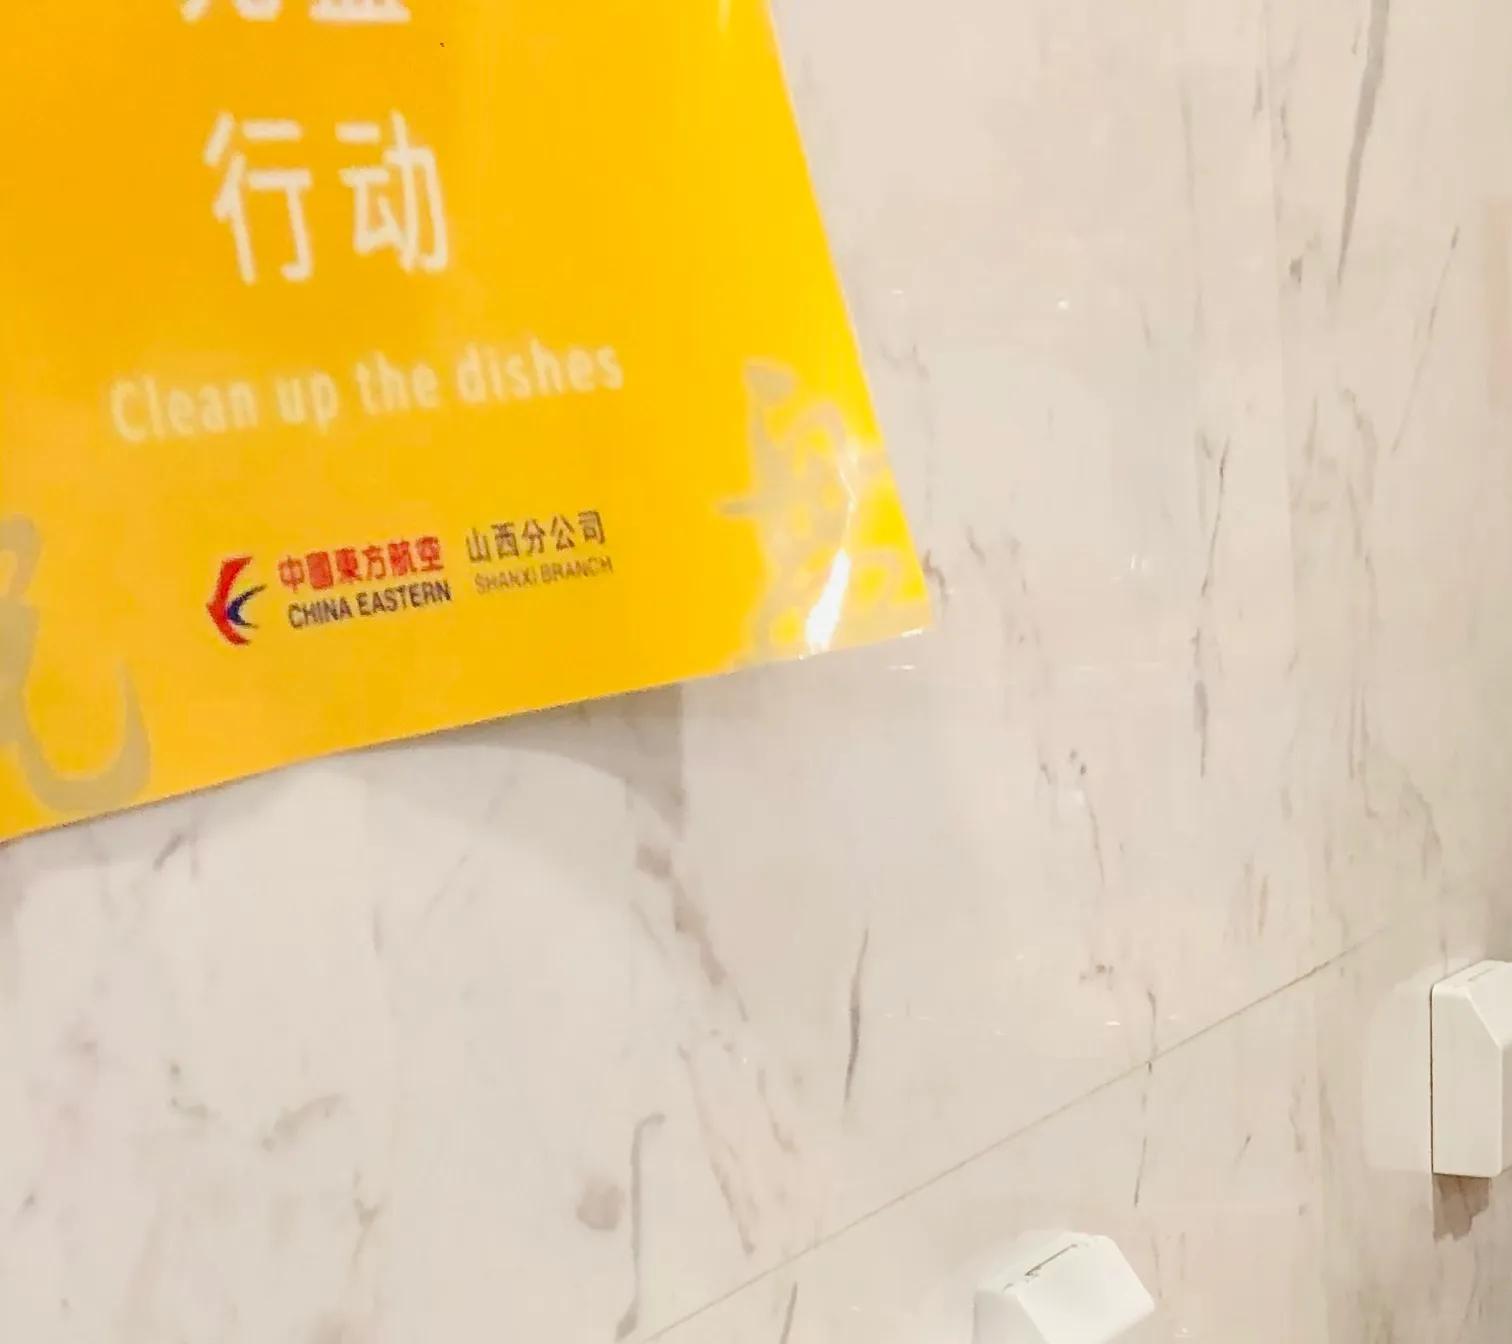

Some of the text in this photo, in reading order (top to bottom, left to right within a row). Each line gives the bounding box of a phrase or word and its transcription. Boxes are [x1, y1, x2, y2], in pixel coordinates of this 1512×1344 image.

[204, 109, 449, 286] 行动
[110, 337, 624, 443] Clean up the dishes
[465, 510, 607, 564] 山西分公司
[473, 555, 614, 596] SHANXI BRANCH
[288, 579, 452, 630] CHINA EASTERN
